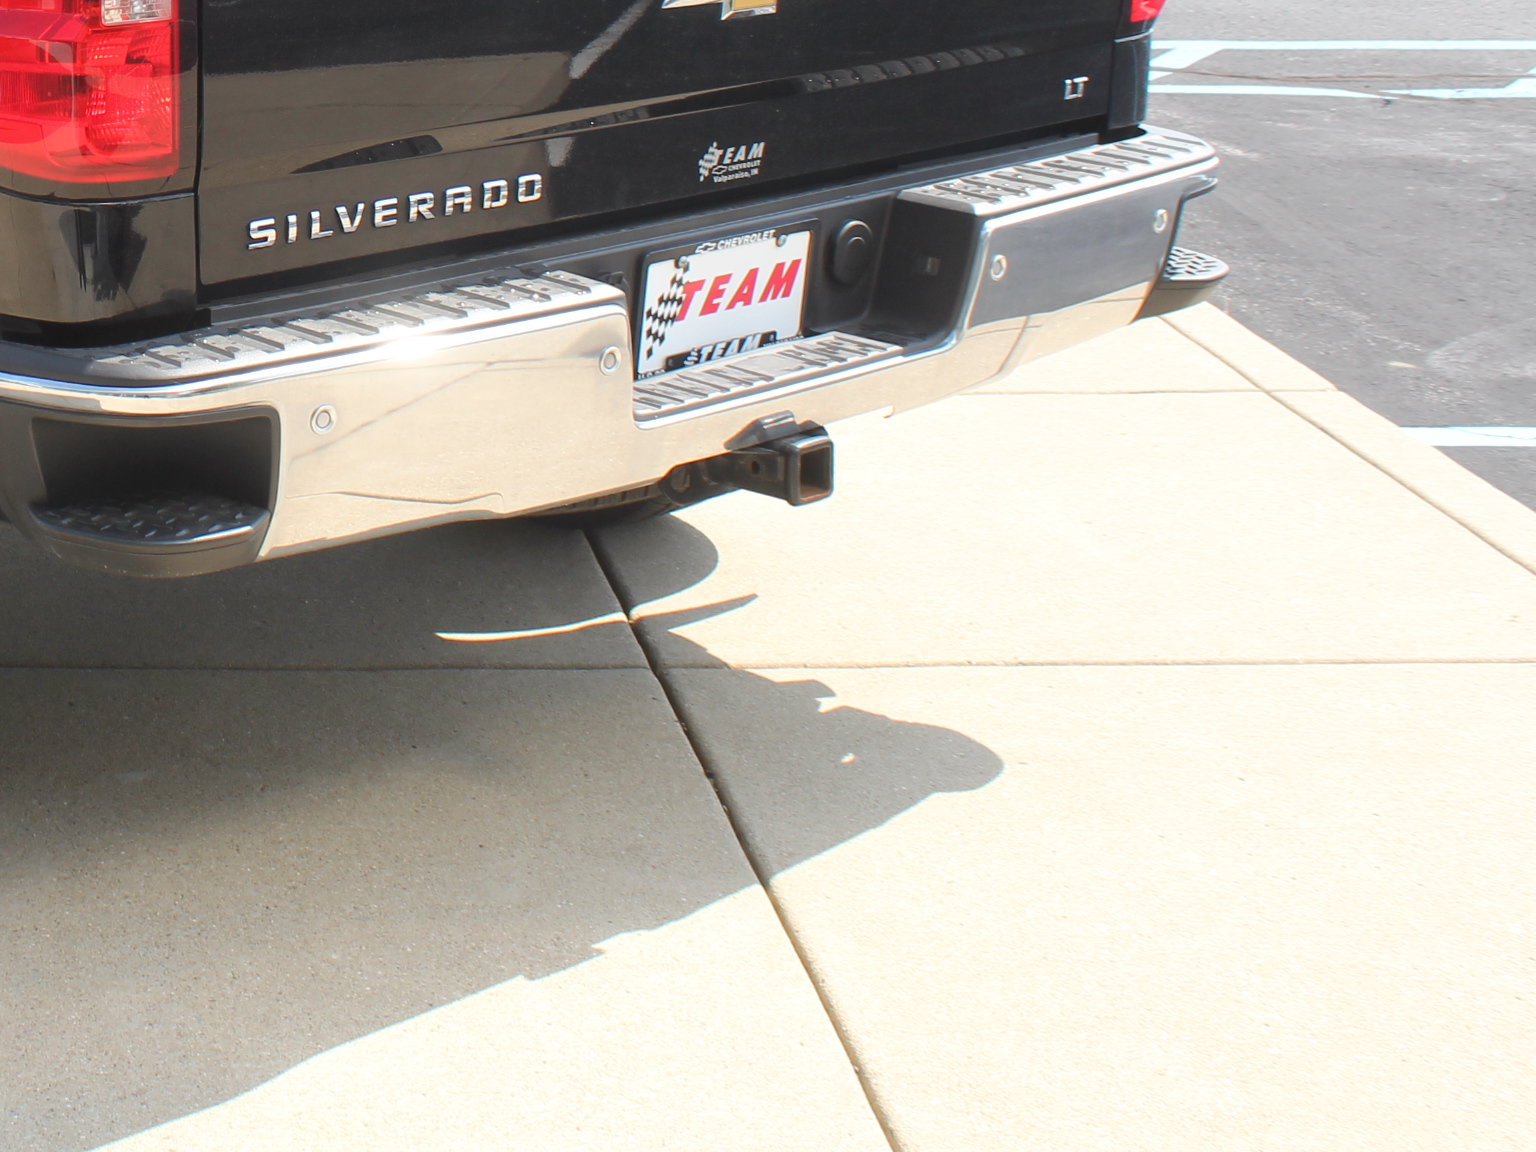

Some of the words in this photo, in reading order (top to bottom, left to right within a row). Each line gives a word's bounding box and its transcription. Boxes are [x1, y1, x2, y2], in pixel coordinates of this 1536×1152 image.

[1064, 76, 1090, 100] LT
[710, 142, 765, 166] TEAM
[728, 160, 761, 171] CHEVROLET
[247, 173, 543, 250] SILVERADO
[717, 230, 775, 250] CHEVROLET
[676, 259, 802, 322] TEAM
[698, 333, 761, 364] TEAM
